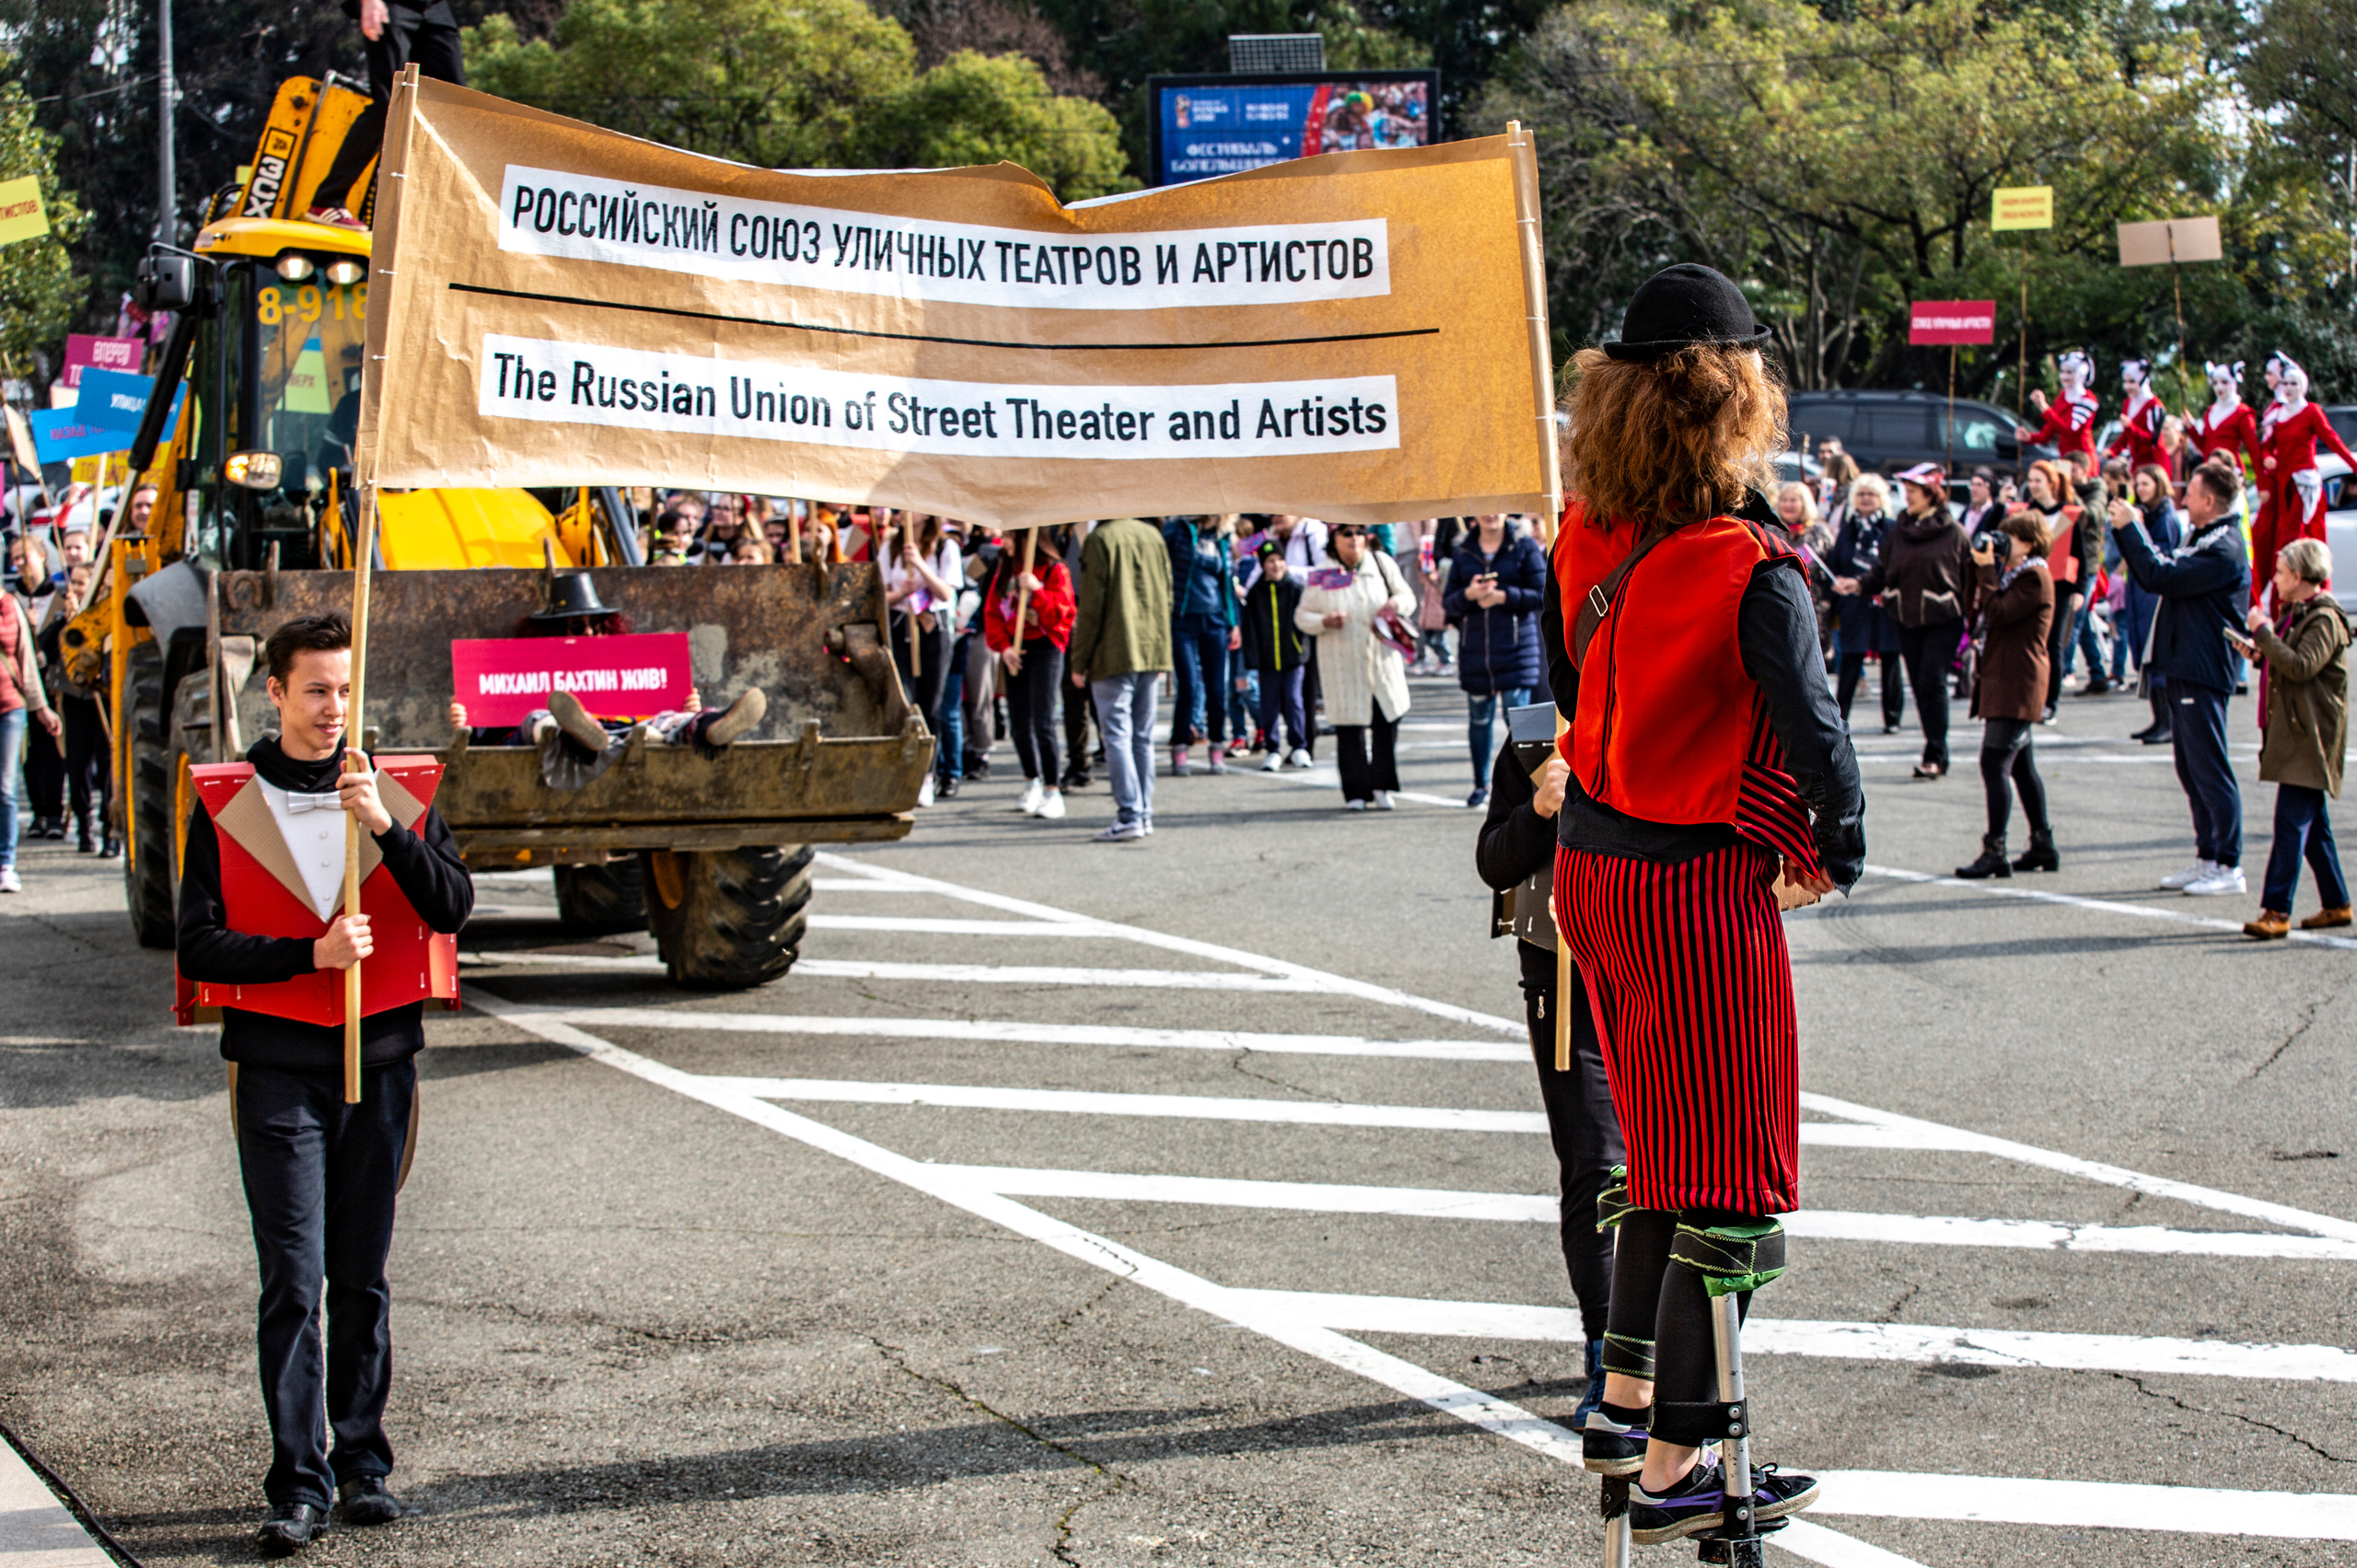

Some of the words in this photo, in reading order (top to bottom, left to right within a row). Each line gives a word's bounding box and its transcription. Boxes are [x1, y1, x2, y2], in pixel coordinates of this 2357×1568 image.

[243, 156, 285, 218] 3CX
[512, 184, 719, 253] РОССИЙСКИЙ
[730, 213, 820, 264] СОЮЗ
[832, 223, 986, 281] УЛИЧНЫХ
[994, 240, 1142, 286] ТЕАТРОВ
[1155, 244, 1178, 285] И
[1192, 238, 1374, 284] АРТИСТОВ
[493, 352, 556, 401] The
[571, 361, 716, 417] Russian
[731, 376, 830, 427] Union
[844, 390, 876, 431] of
[888, 392, 998, 439] Street
[1005, 398, 1155, 441] Theater
[1168, 399, 1241, 440] and
[1256, 395, 1387, 439] Artists
[479, 671, 551, 695] МИХАИЛ
[553, 669, 618, 692] БАХТИН
[621, 668, 668, 691] ЖИВ!
